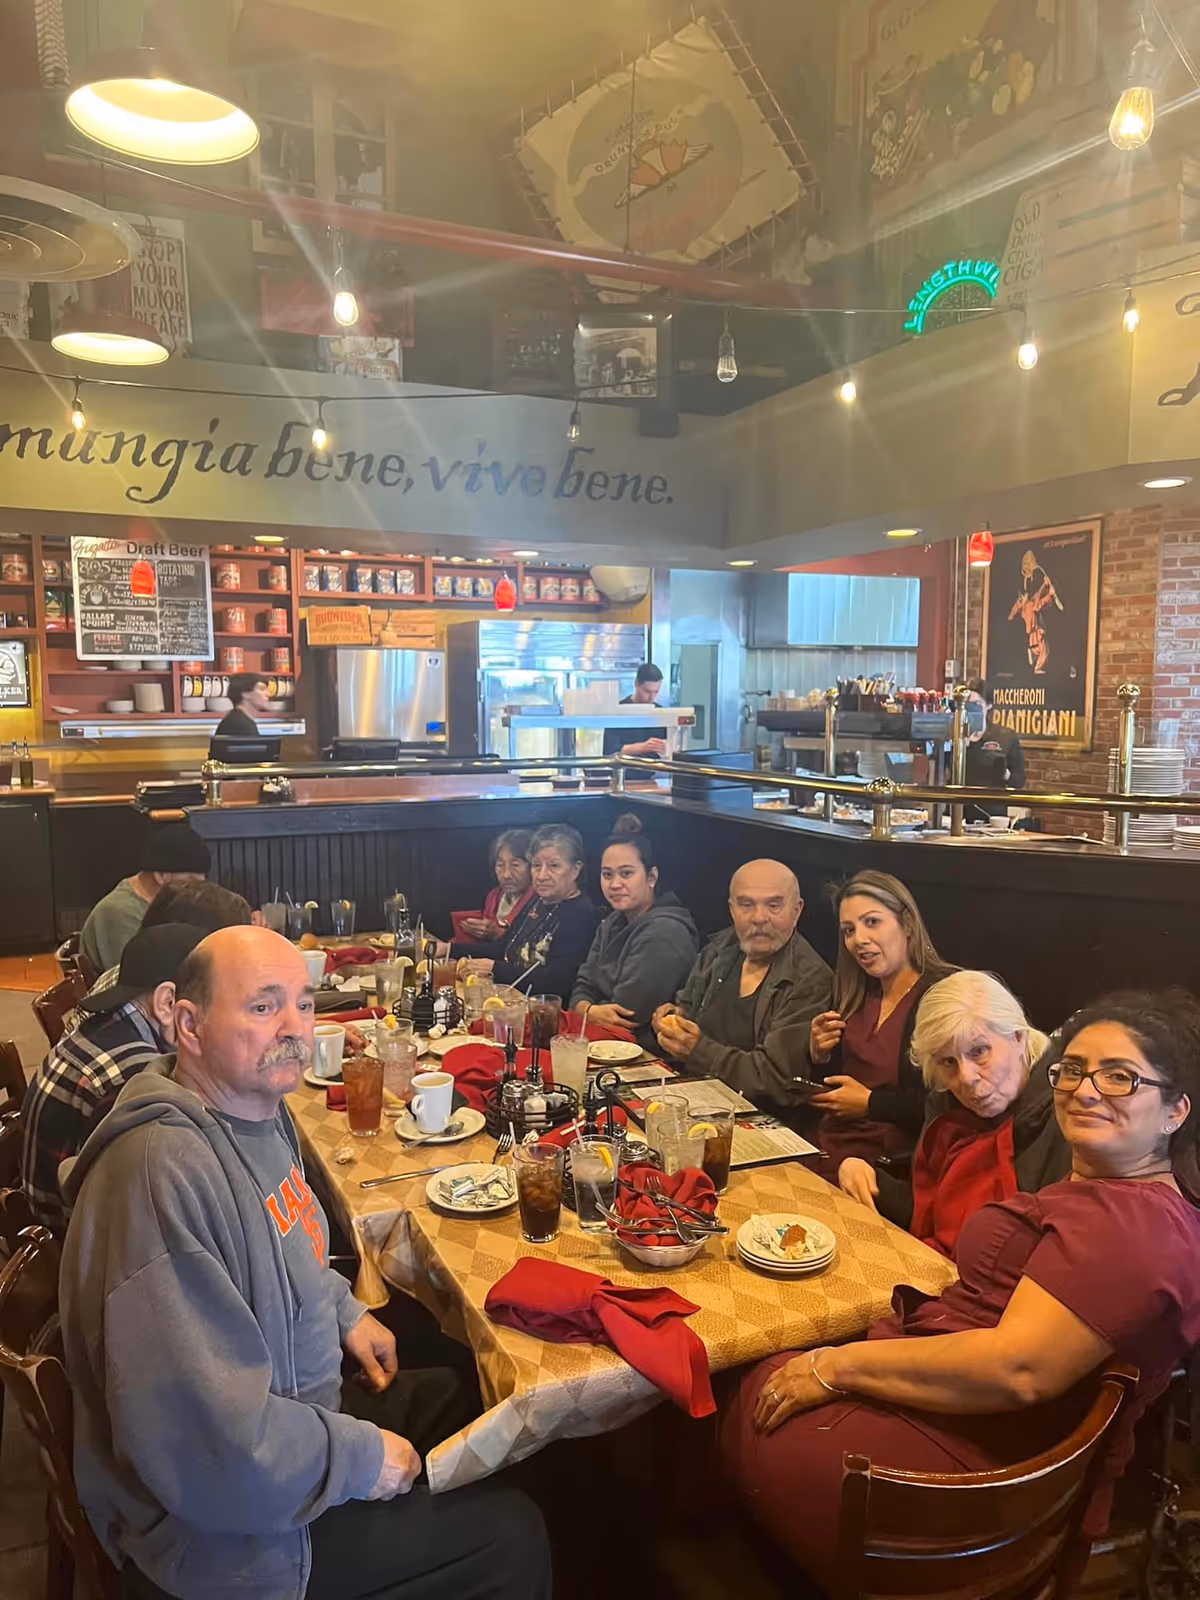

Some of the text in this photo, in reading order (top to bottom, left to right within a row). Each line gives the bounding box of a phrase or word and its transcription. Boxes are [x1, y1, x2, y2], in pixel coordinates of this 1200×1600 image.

[137, 261, 178, 289] YOUR
[0, 417, 673, 504] mangia bene, vive bene.
[126, 541, 164, 556] Draft
[168, 543, 205, 557] Beer
[79, 560, 111, 575] 805
[993, 688, 1045, 705] MACCHERONI
